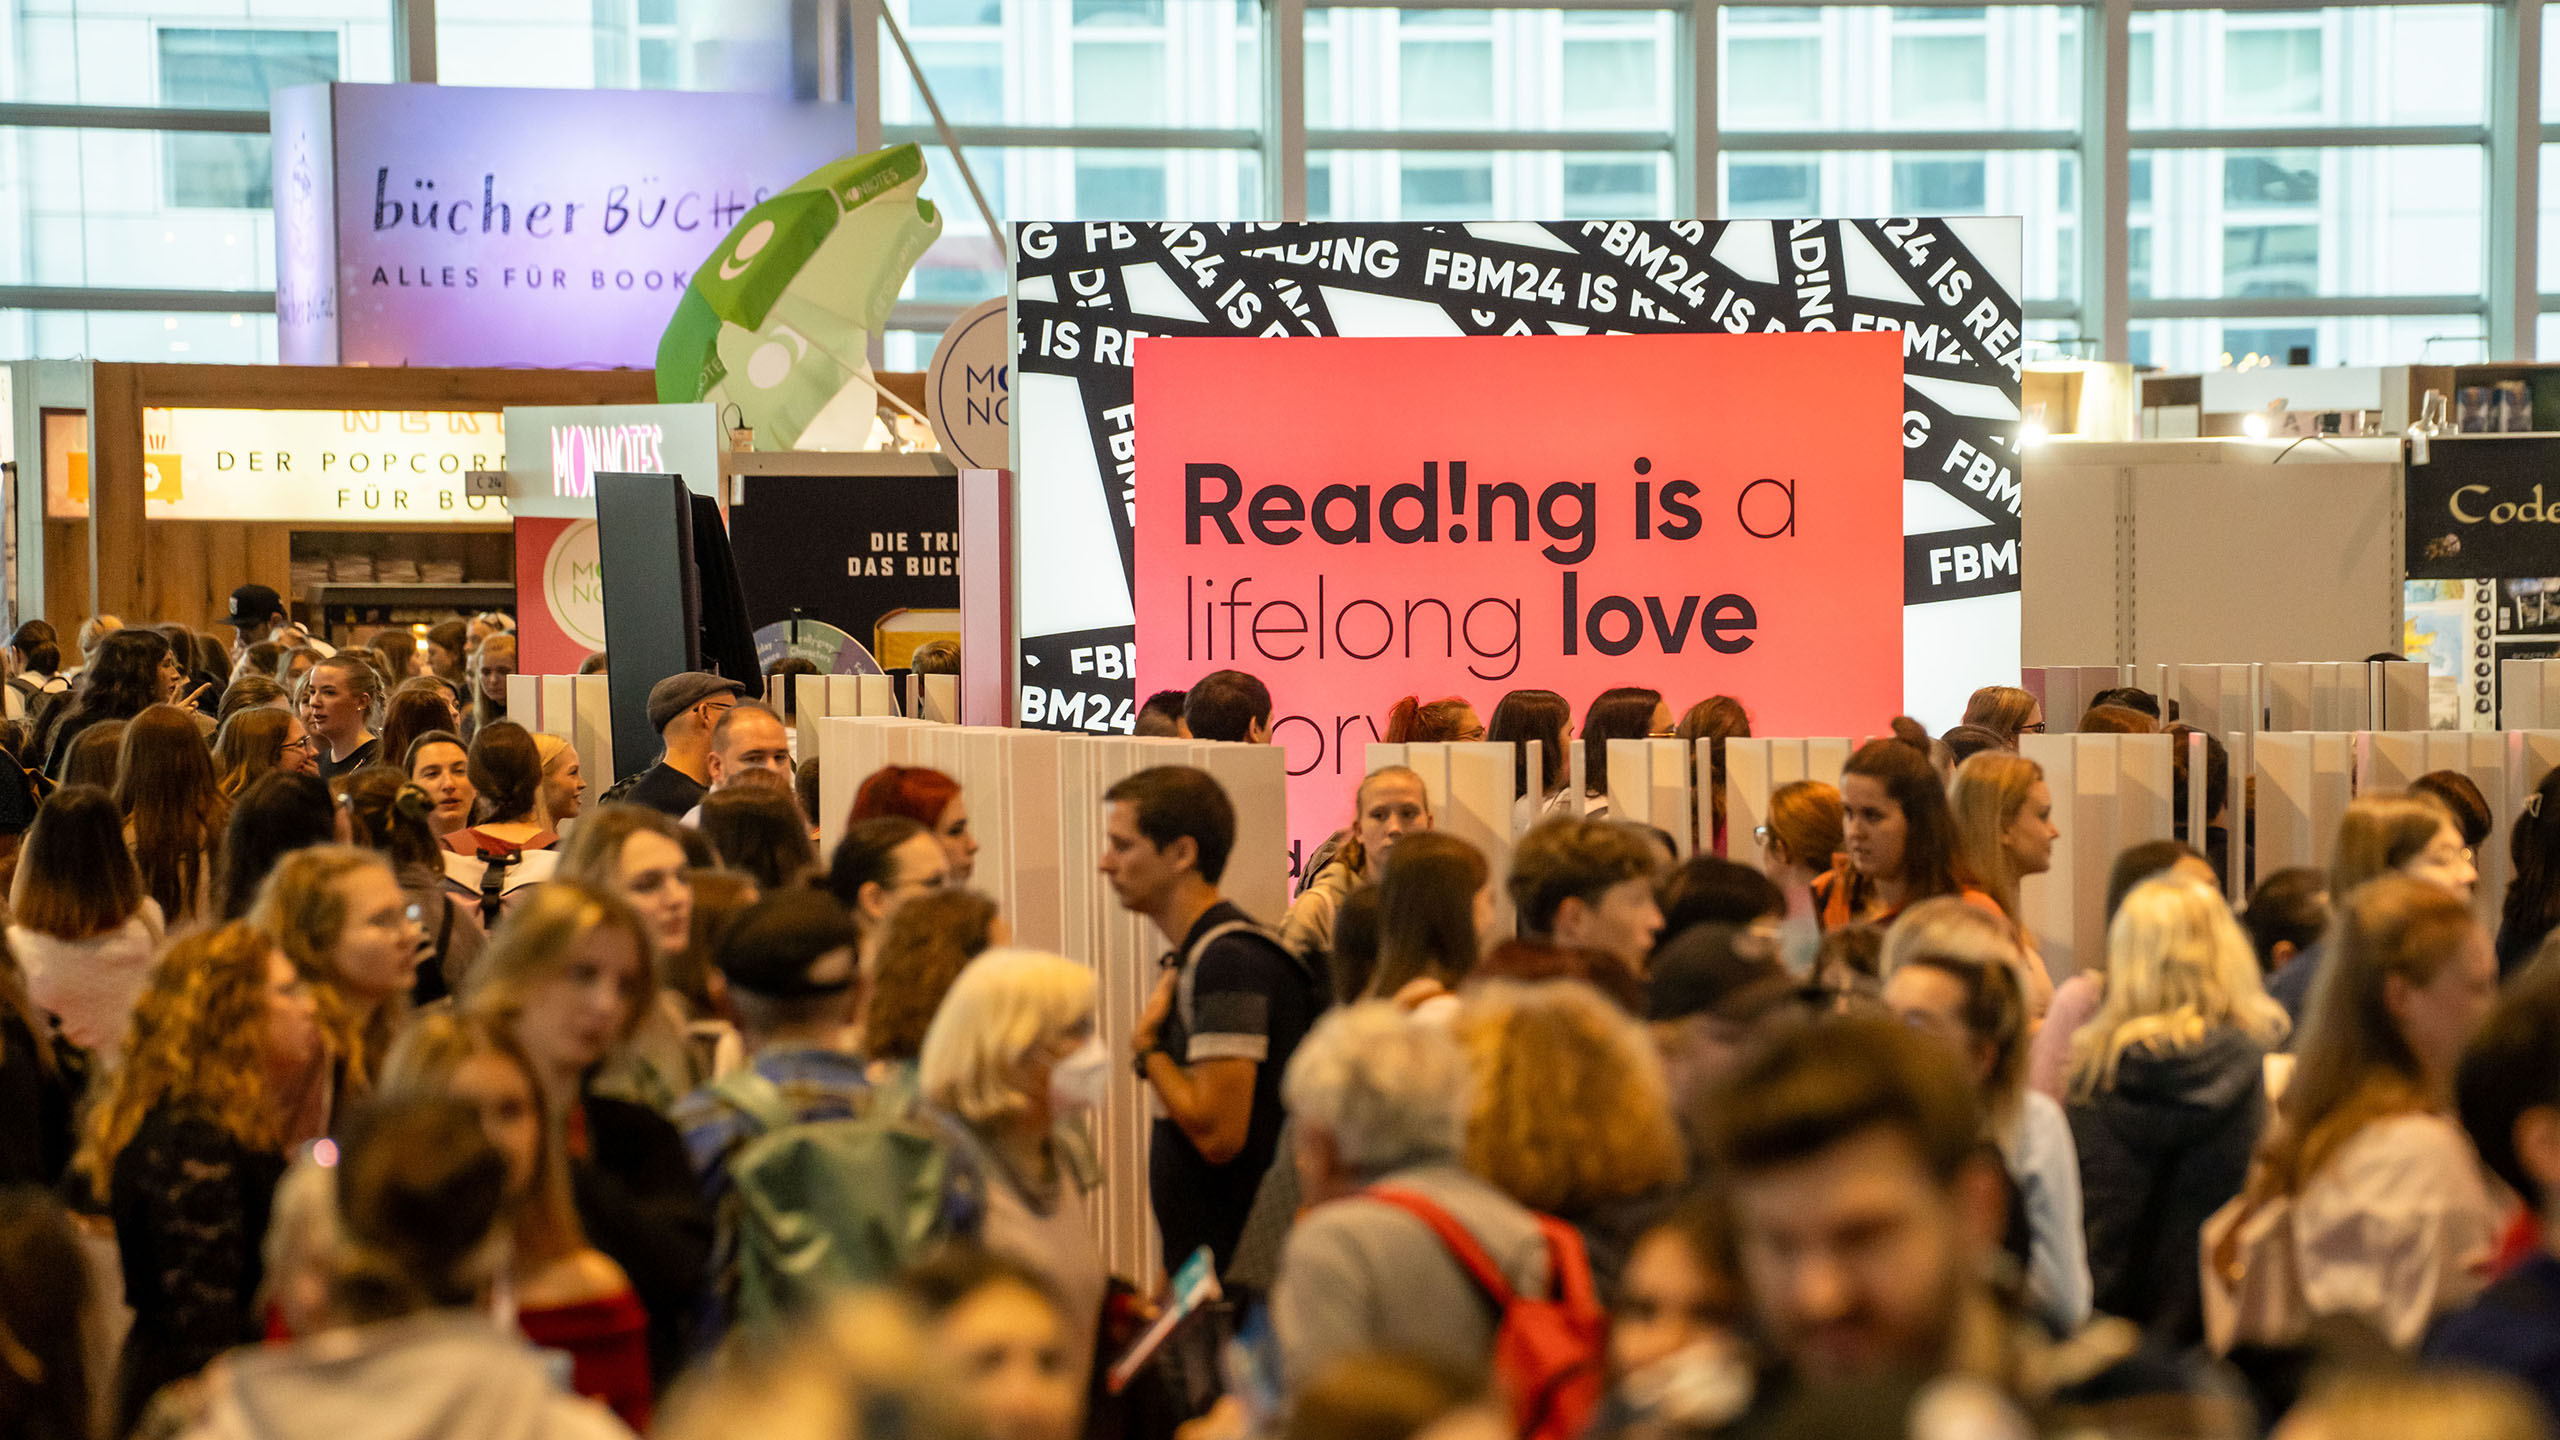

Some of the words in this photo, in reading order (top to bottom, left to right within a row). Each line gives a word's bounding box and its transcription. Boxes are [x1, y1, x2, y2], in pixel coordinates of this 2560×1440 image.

[372, 166, 584, 239] bücher
[372, 265, 478, 289] ALLES
[504, 263, 567, 290] FÜR
[1424, 247, 1566, 305] FBM24
[1577, 272, 1619, 313] IS
[1926, 256, 1973, 307] IS
[1216, 278, 1263, 329] IS
[1710, 288, 1756, 334] IS
[1040, 318, 1081, 360] IS
[341, 410, 505, 434] NER
[216, 451, 291, 473] DER
[1941, 438, 2022, 518] FBM
[338, 483, 408, 510] FÜR
[1184, 460, 1597, 565] Read!ng
[1634, 456, 1702, 541] is
[1737, 478, 1796, 539] a
[870, 532, 909, 552] DIE
[1929, 538, 2021, 586] FBM
[848, 556, 894, 577] DAS
[1186, 574, 1522, 682] lifelong
[1562, 571, 1758, 657] love
